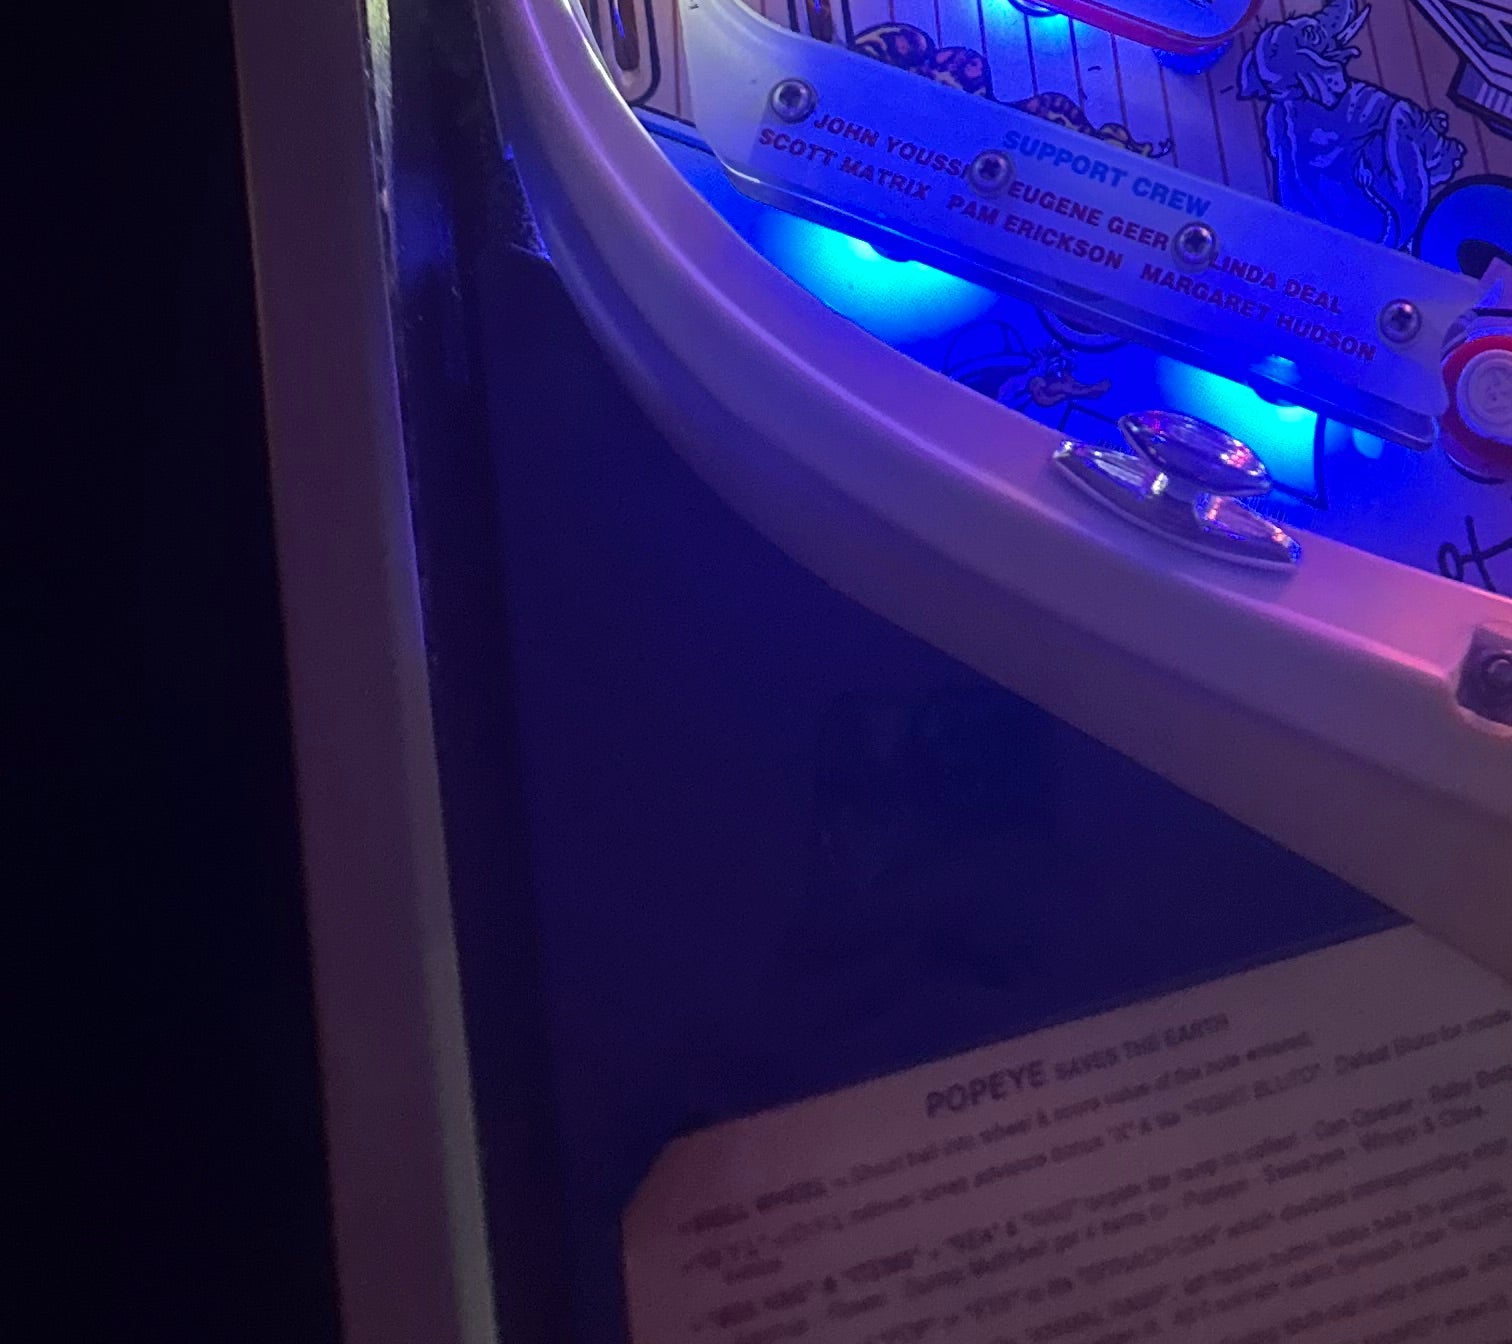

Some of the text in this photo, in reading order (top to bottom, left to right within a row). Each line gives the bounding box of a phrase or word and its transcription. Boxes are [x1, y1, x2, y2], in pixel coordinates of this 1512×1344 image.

[758, 127, 1379, 363] SCOTT MATRIX PAM ERICKSON MARGARET HUDSON
[813, 113, 880, 149] JOHN
[1008, 180, 1105, 229] EUGENE
[1106, 214, 1171, 253] GEER
[1208, 254, 1279, 292] LINDA
[1283, 277, 1345, 315] DEAL
[1001, 129, 1214, 219] SUPPORT CREW
[925, 1058, 1047, 1119] POPEYE
